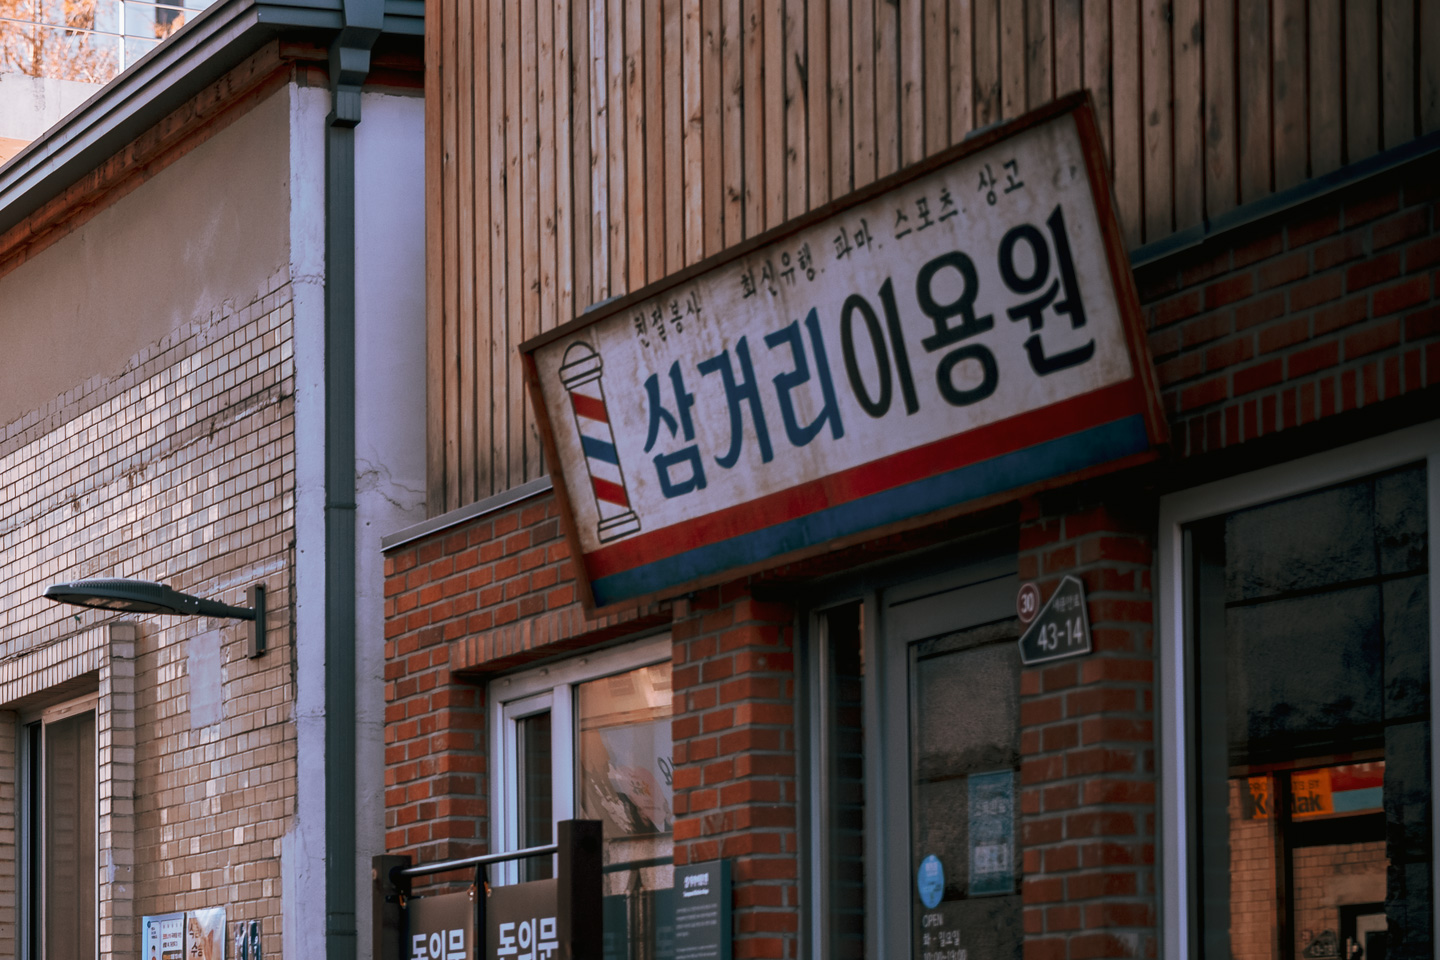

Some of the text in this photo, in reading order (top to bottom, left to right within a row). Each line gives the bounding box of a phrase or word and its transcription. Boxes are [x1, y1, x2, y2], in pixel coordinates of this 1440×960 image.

[634, 289, 702, 348] 친절봉사
[976, 158, 1024, 206] 상고
[642, 203, 1096, 499] 삼거리이용원
[1020, 591, 1035, 614] 30
[1037, 616, 1083, 652] 43-14
[922, 913, 944, 928] OPEN
[938, 930, 960, 947] 일요일
